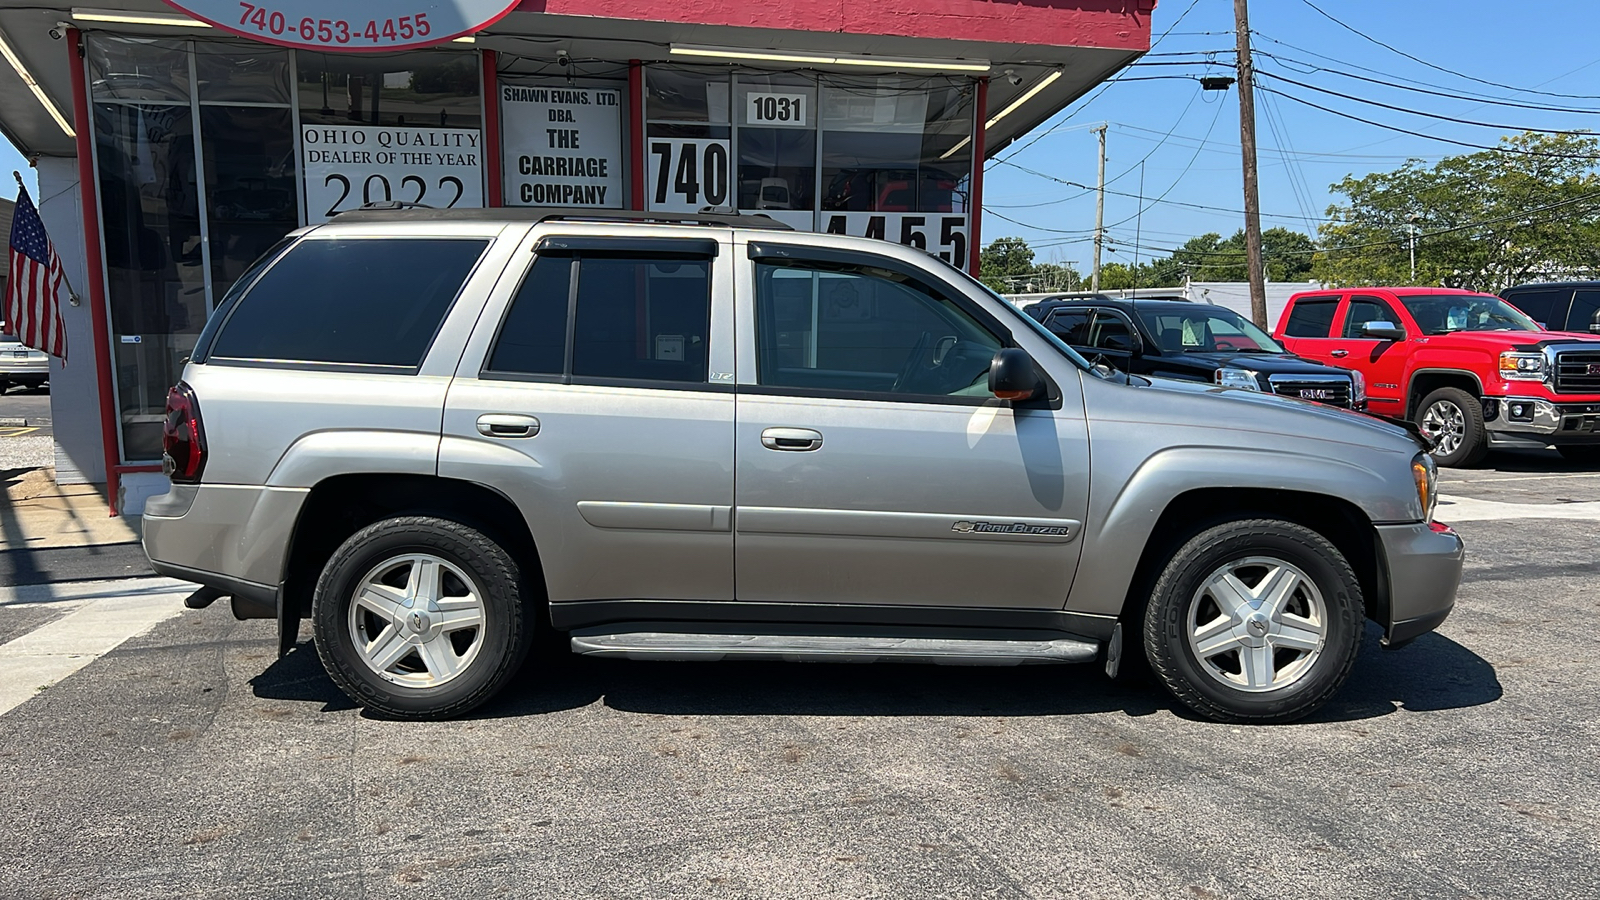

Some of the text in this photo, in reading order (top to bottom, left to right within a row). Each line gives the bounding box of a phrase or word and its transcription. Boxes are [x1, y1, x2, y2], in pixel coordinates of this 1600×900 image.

[238, 1, 431, 44] 740-653-4455
[503, 88, 548, 103] SHAWN
[596, 92, 619, 106] LTD.
[548, 109, 576, 123] DBA.
[753, 97, 800, 121] 1031
[305, 128, 479, 148] OHIO QUALITY
[546, 128, 580, 149] THE
[308, 150, 478, 167] DEALER OF THE YEAR
[518, 155, 608, 178] CARRIAGE
[651, 142, 728, 205] 740
[324, 174, 464, 217] 2022
[520, 183, 607, 205] COMPANY
[826, 215, 966, 273] 55
[976, 522, 1067, 535] TRAILBLAZER
